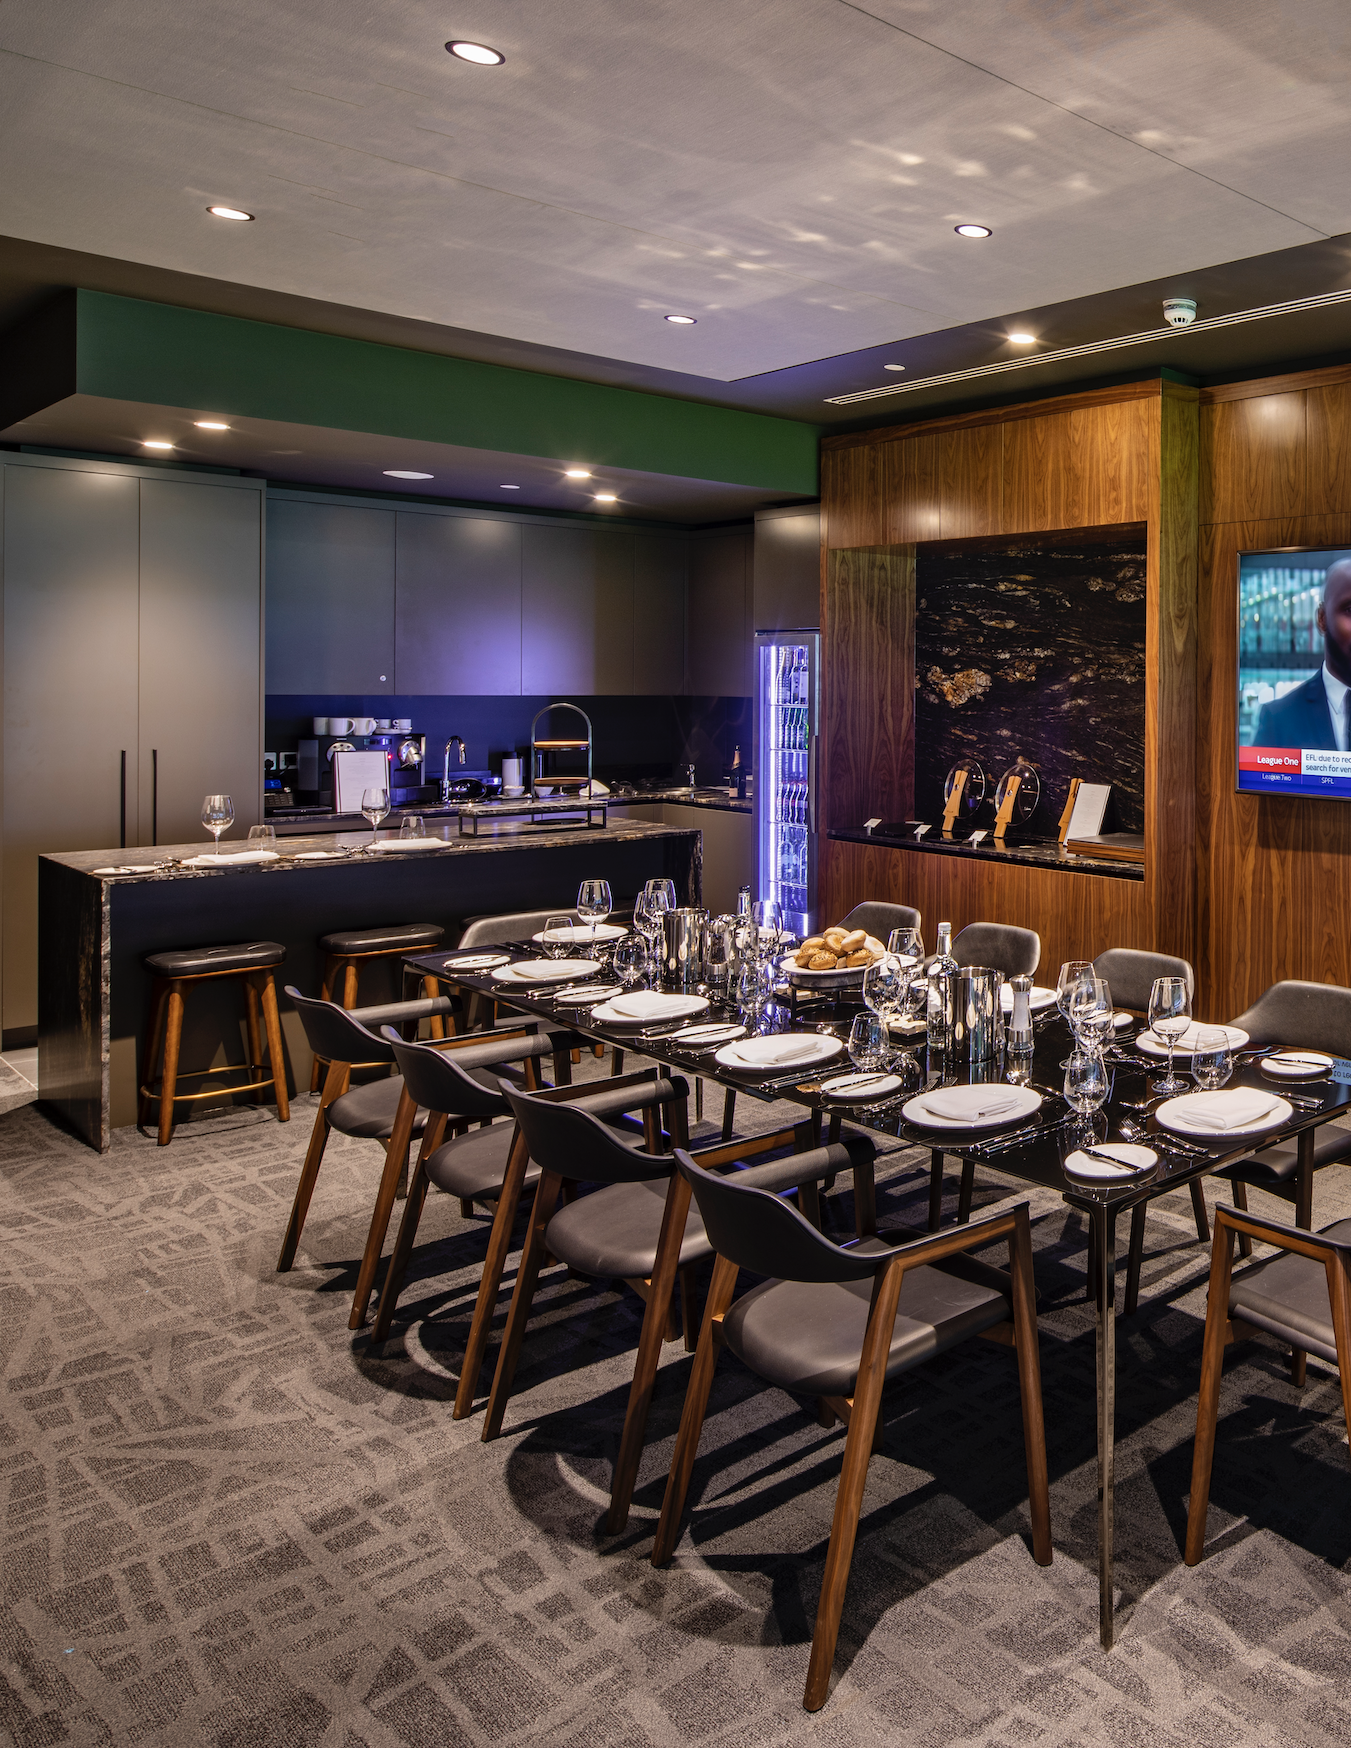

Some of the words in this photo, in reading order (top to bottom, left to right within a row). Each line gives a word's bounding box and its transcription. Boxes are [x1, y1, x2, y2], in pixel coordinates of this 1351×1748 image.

[1257, 756, 1282, 766] League
[1284, 757, 1299, 766] One
[1306, 764, 1328, 772] search
[1329, 764, 1339, 772] for
[1262, 773, 1280, 781] League
